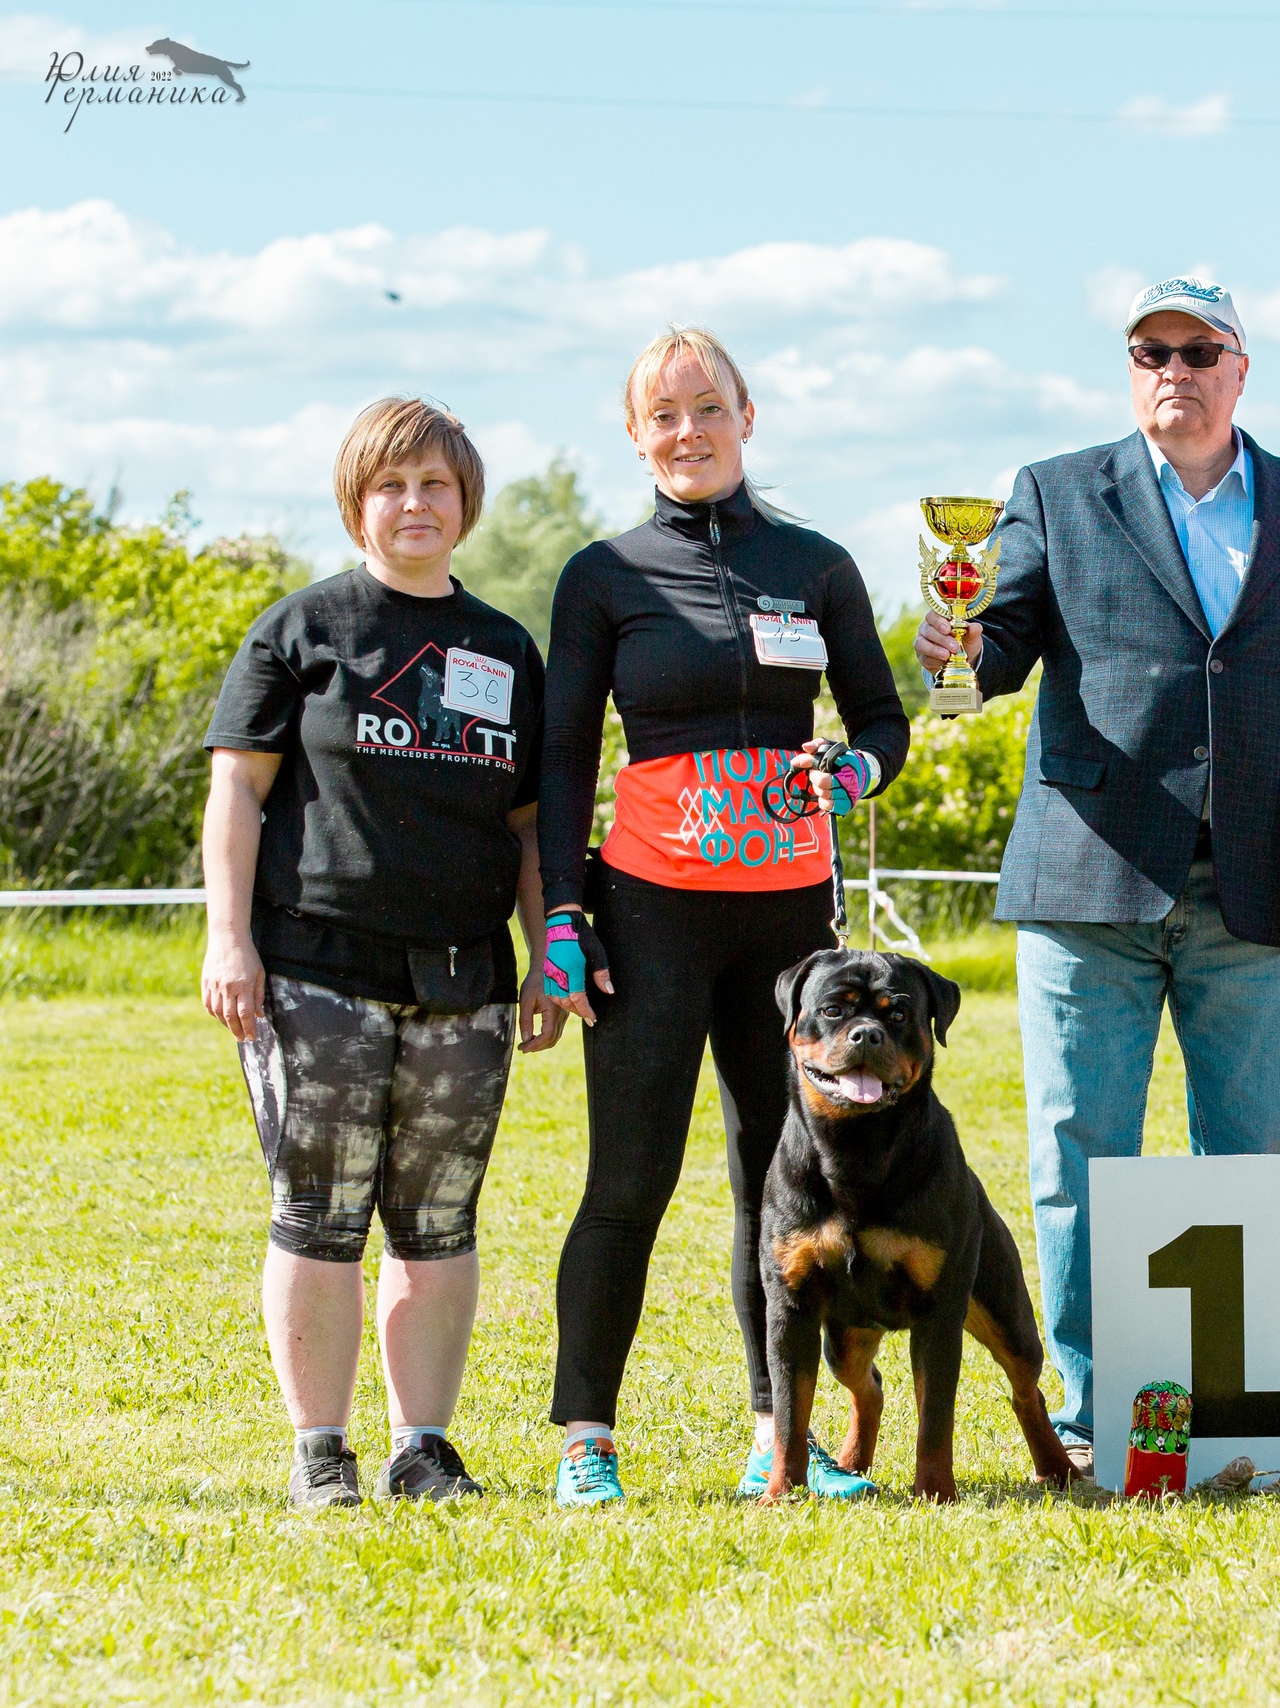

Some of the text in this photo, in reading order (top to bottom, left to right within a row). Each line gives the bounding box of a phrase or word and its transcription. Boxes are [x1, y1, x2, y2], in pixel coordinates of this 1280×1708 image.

[758, 616, 812, 625] ROYAL ANIN
[452, 657, 507, 679] ROYAL CANIN
[457, 670, 499, 704] 36
[356, 746, 516, 774] THE MERCEDES FROM THE DOGS
[700, 828, 795, 867] ФОН
